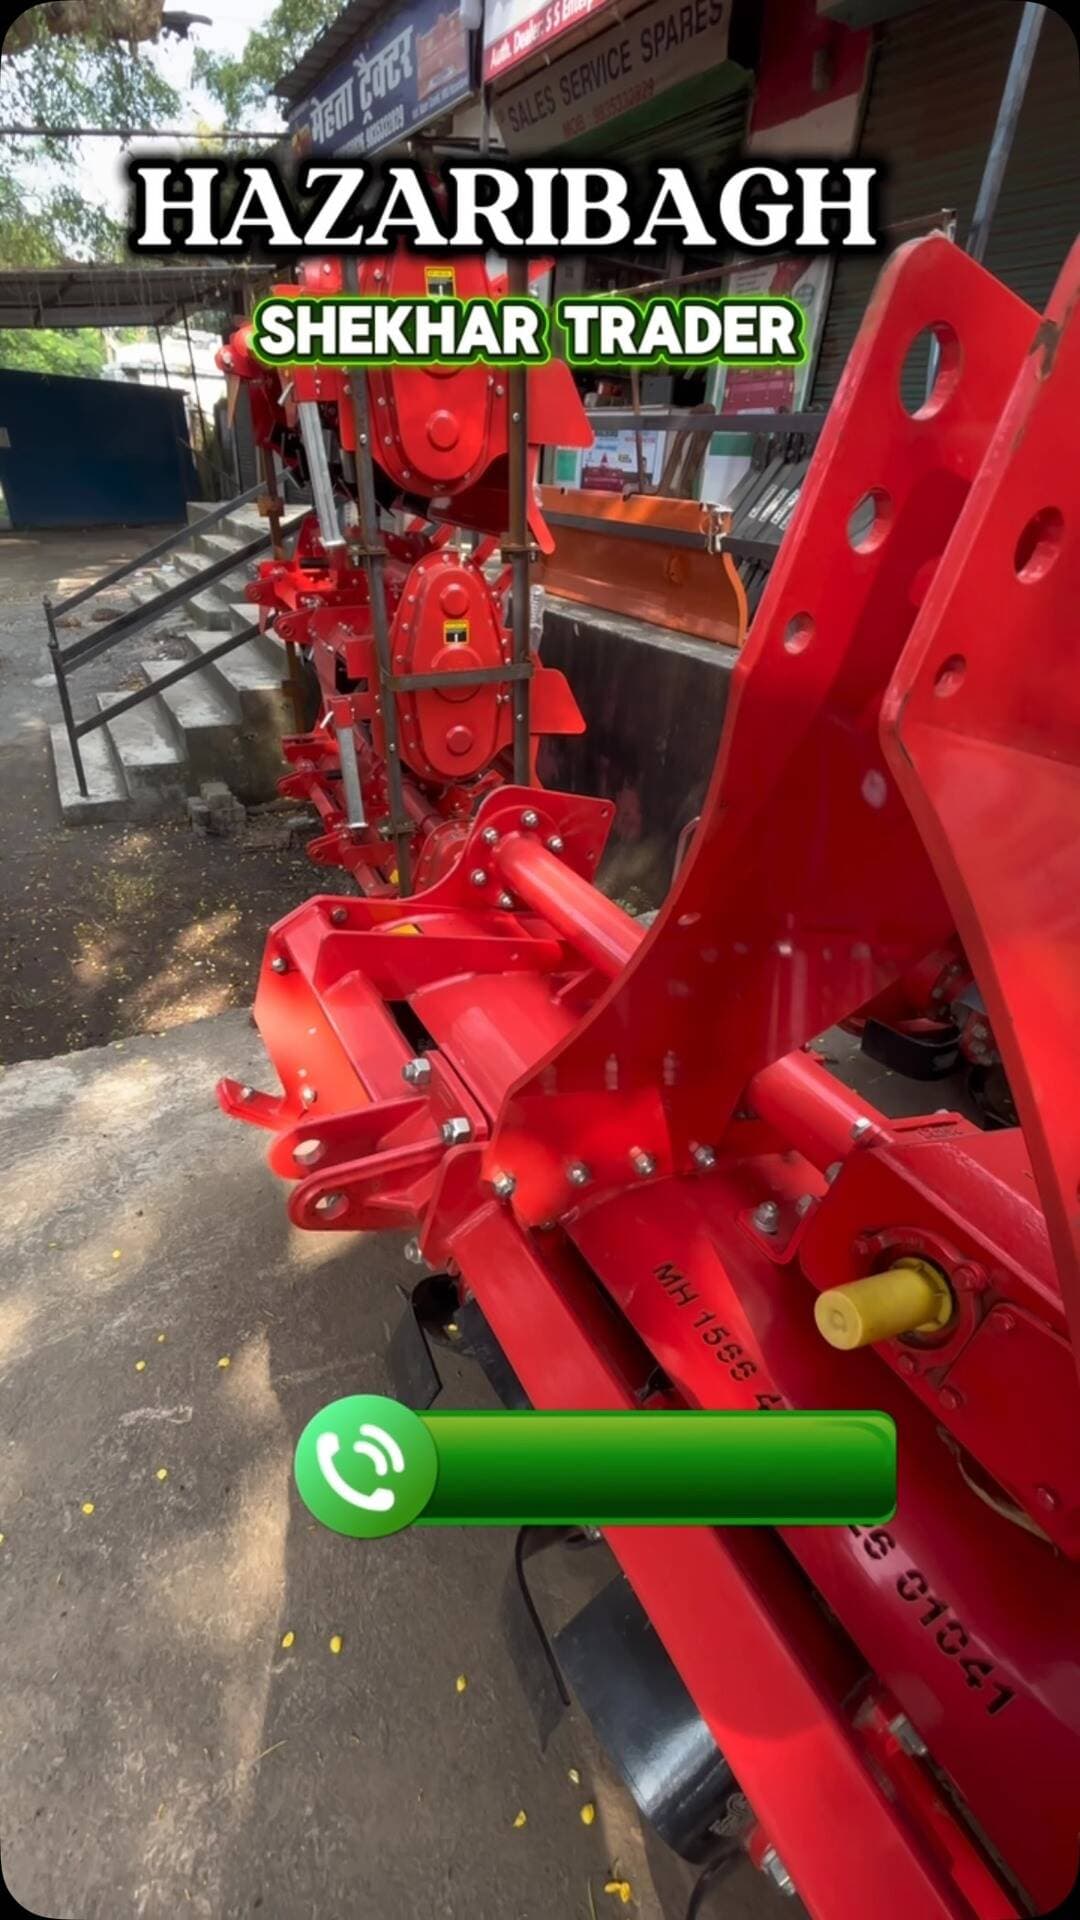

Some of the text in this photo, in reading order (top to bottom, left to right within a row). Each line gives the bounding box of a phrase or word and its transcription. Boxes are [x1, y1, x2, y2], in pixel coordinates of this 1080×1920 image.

[310, 75, 354, 144] मेहता
[353, 25, 414, 125] ट्रैक्टर
[507, 84, 556, 133] SALES
[559, 39, 632, 106] SERVICE
[640, 0, 724, 63] SPARES
[653, 1263, 699, 1307] MH
[694, 1311, 758, 1382] 1566
